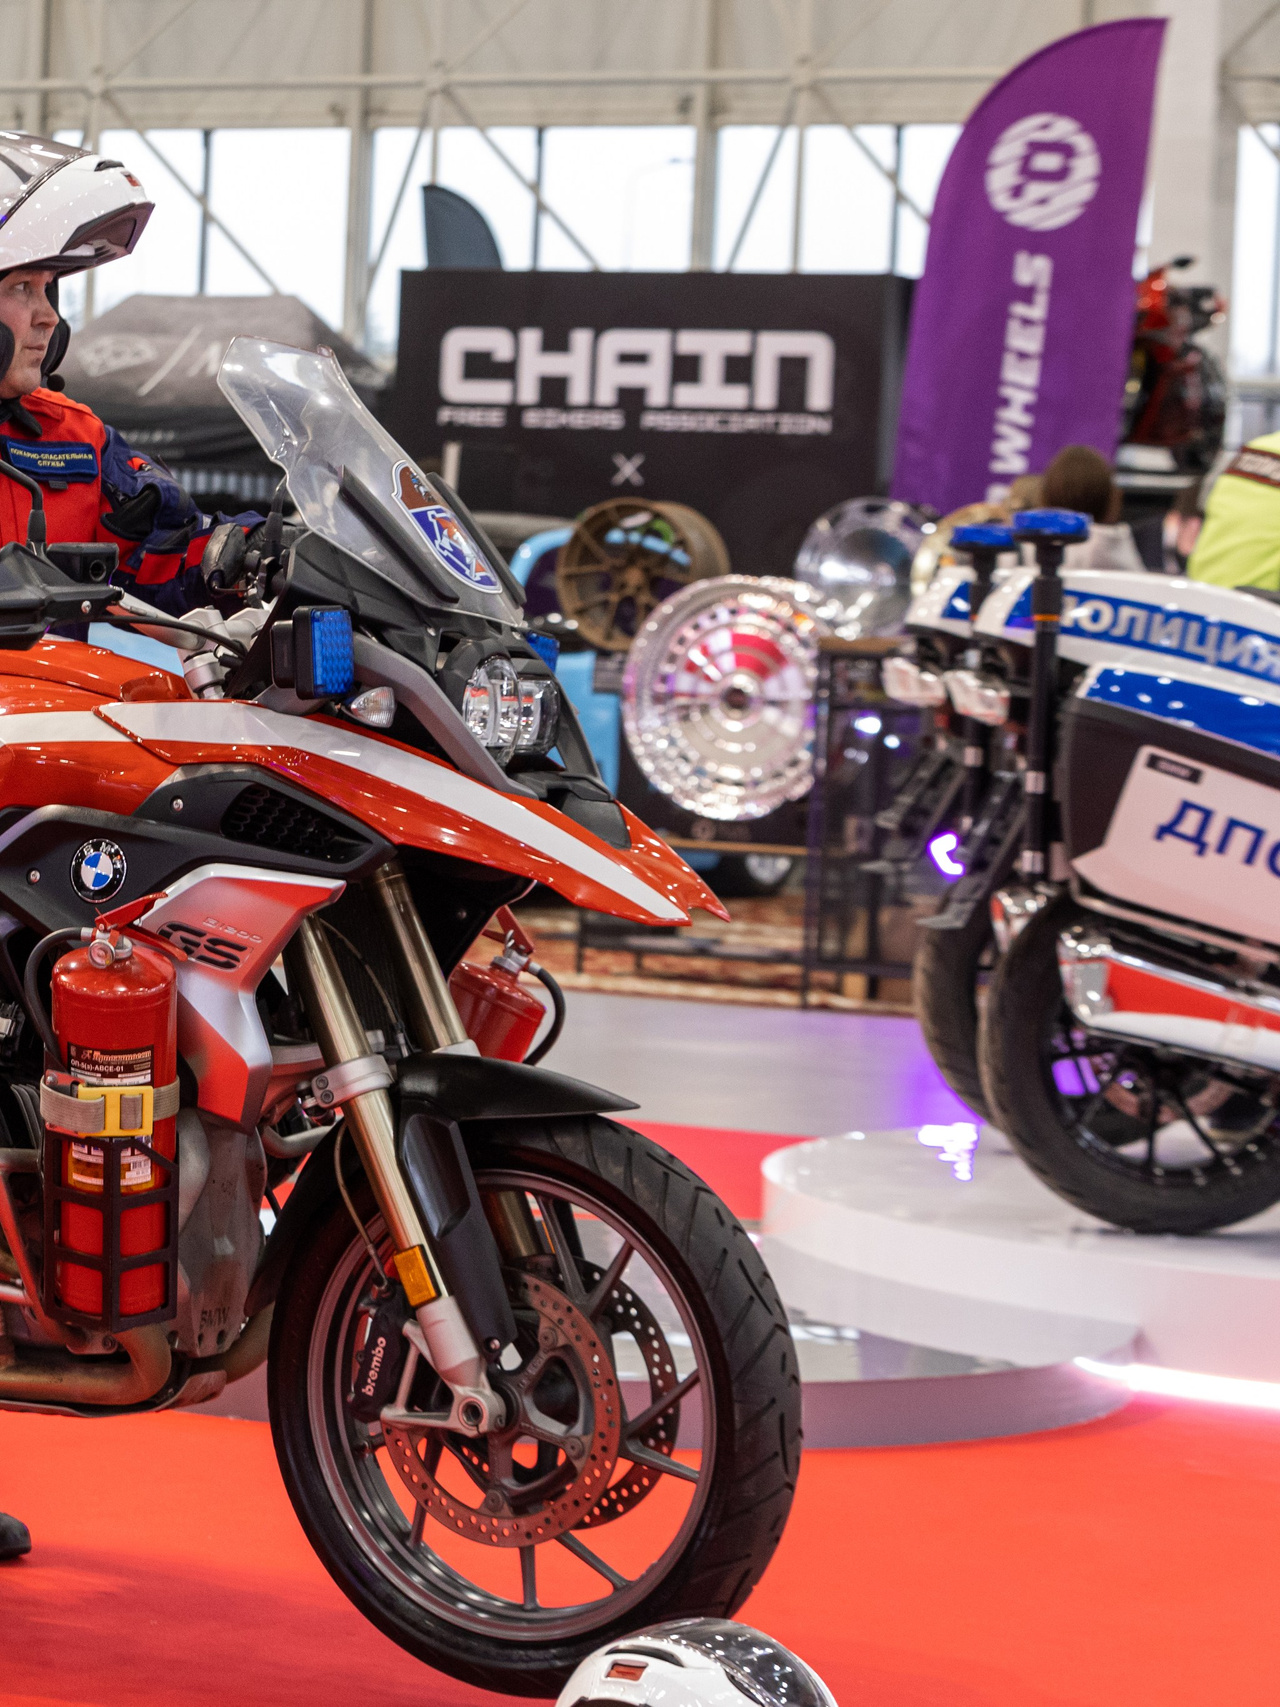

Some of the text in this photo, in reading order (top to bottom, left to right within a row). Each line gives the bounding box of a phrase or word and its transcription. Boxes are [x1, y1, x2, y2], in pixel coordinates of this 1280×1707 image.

[439, 325, 836, 412] CHAIN
[988, 250, 1053, 475] WHEELS
[437, 406, 832, 435] FREE BIKERS ASSOCIATION
[10, 447, 93, 460] ПОЖАРНО-СПАСАТЕЛЬНАЯ
[37, 460, 65, 468] СЛУЖБА
[361, 1336, 387, 1397] brembo
